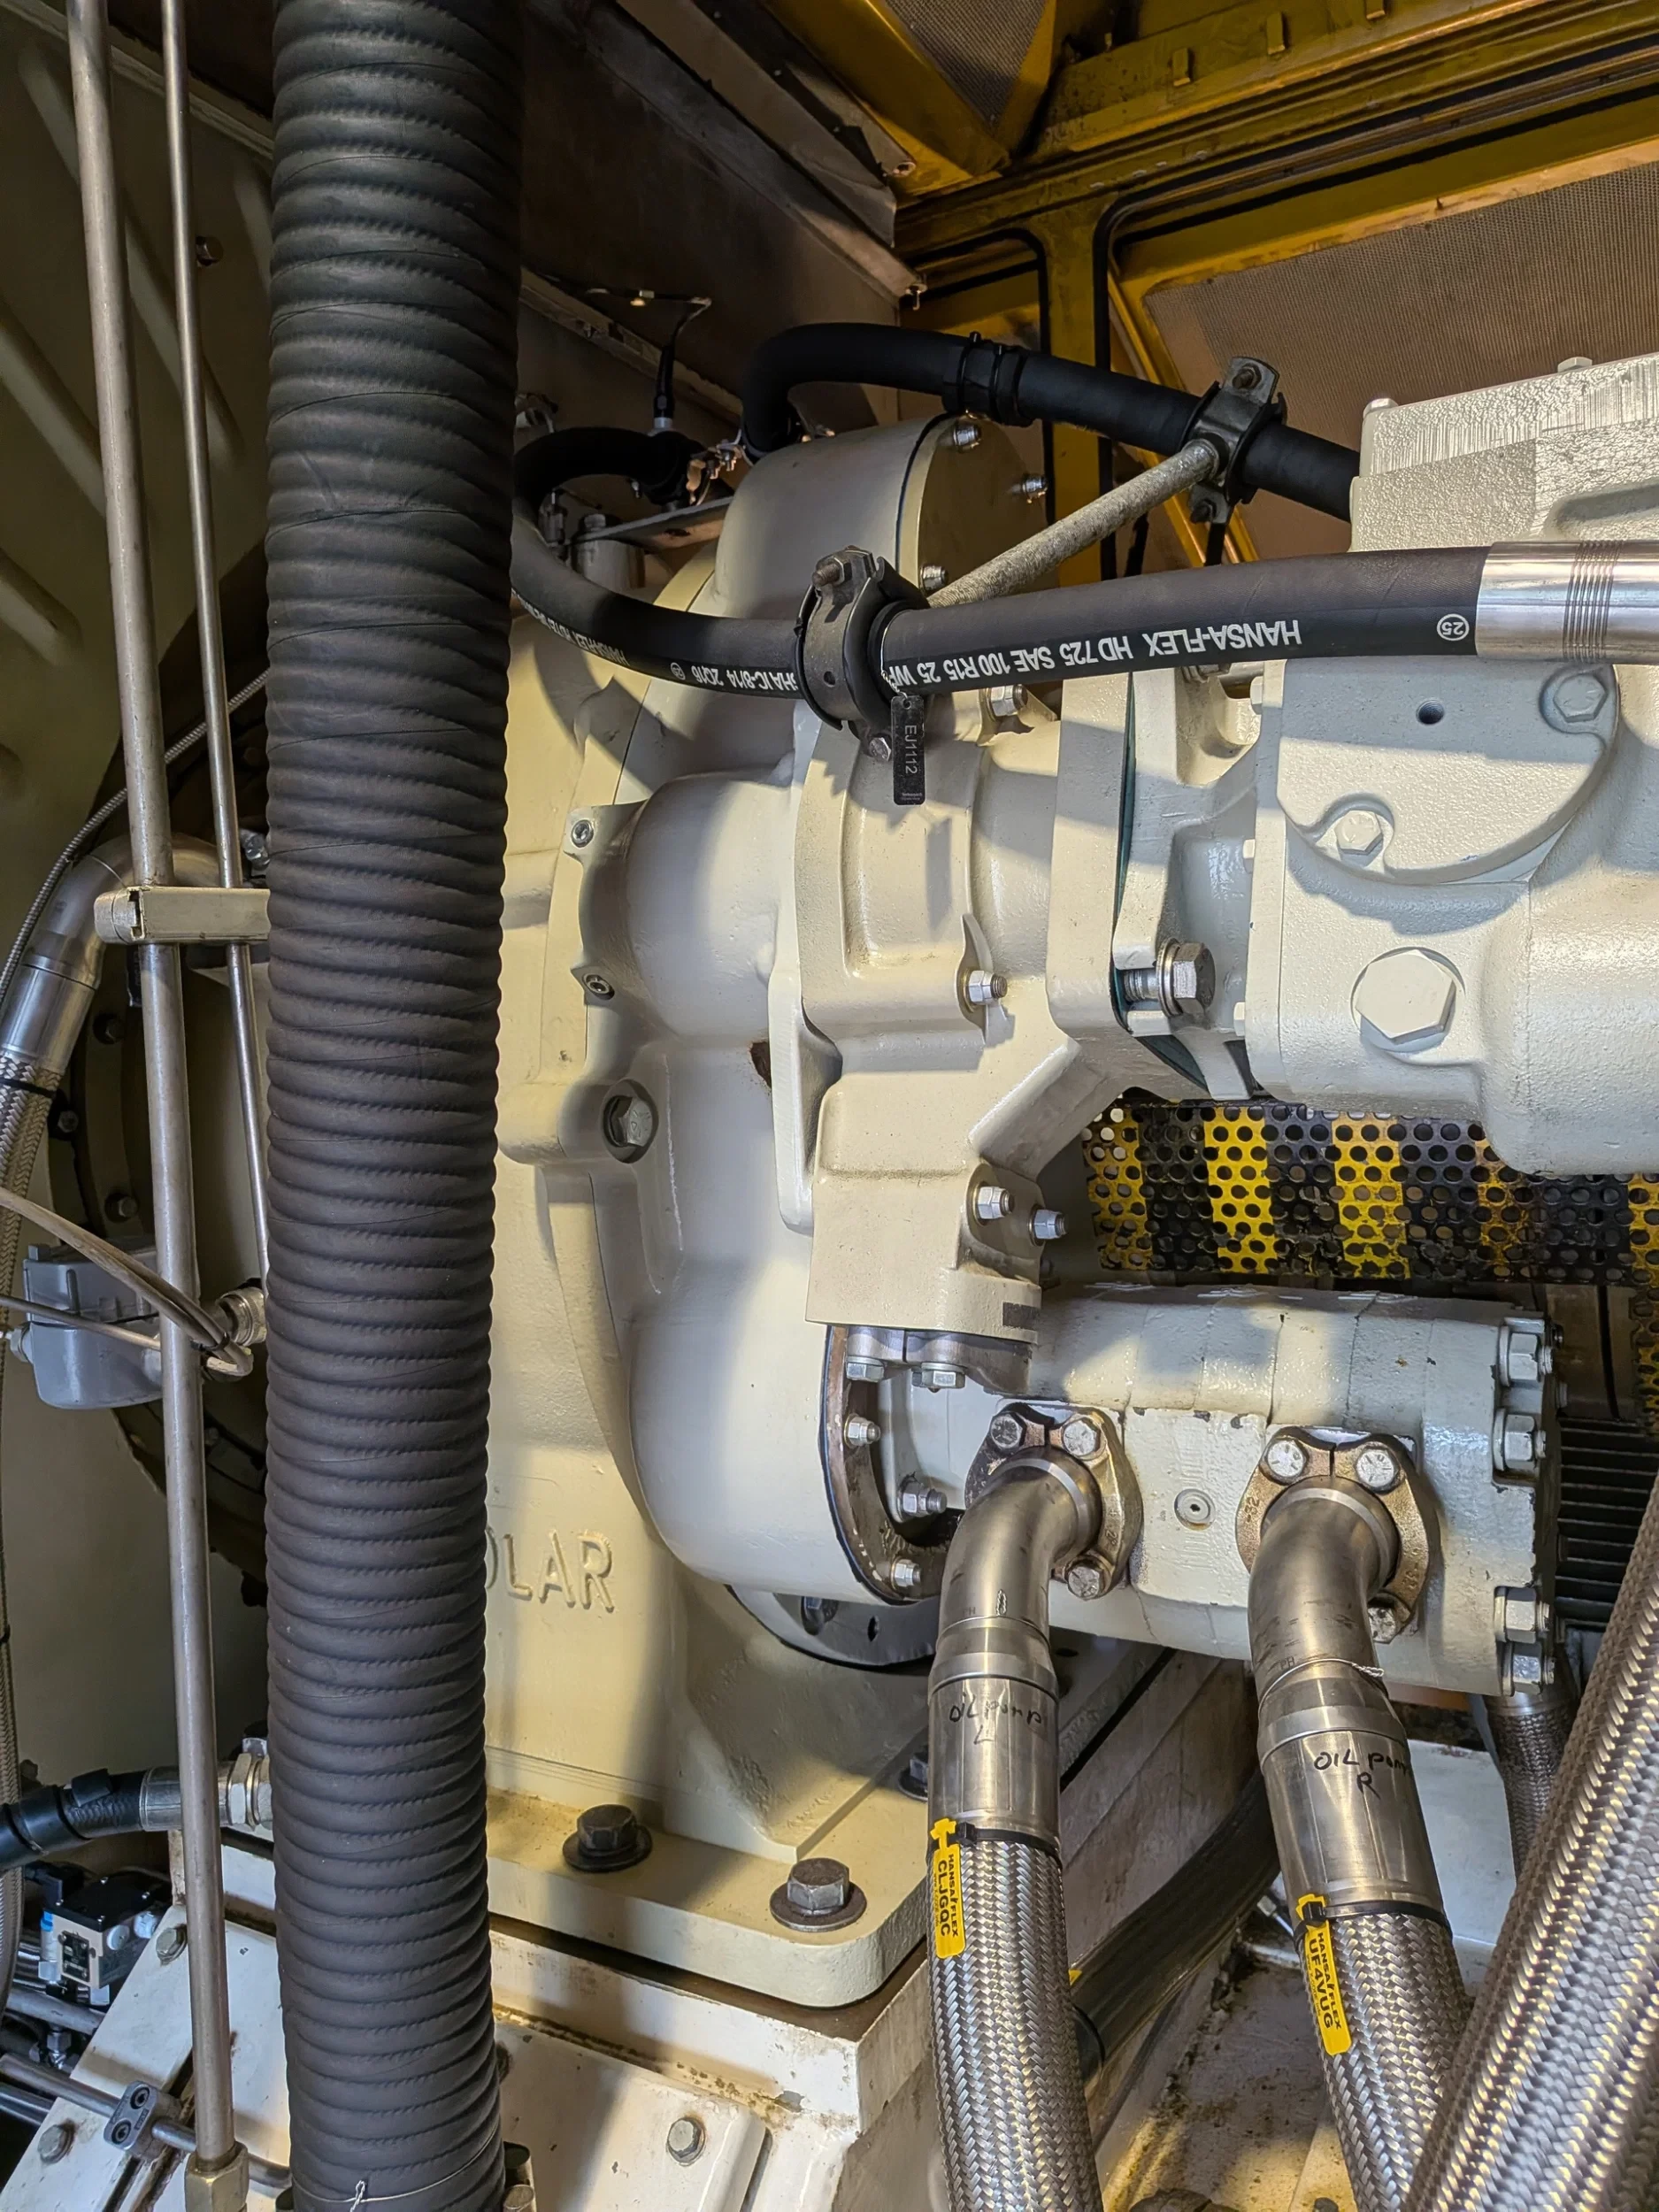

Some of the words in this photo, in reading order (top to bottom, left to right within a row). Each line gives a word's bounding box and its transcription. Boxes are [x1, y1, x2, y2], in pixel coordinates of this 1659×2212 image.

[1142, 619, 1302, 657] HANSA-FLEX
[1440, 620, 1465, 636] 25
[917, 662, 941, 684] 25
[942, 656, 980, 680] R15
[1010, 646, 1055, 672] SAE
[904, 725, 918, 774] EJ1112
[1356, 1771, 1381, 1801] R
[938, 1859, 951, 1937] CLJGQC
[1309, 1939, 1334, 2029] UF4VUG
